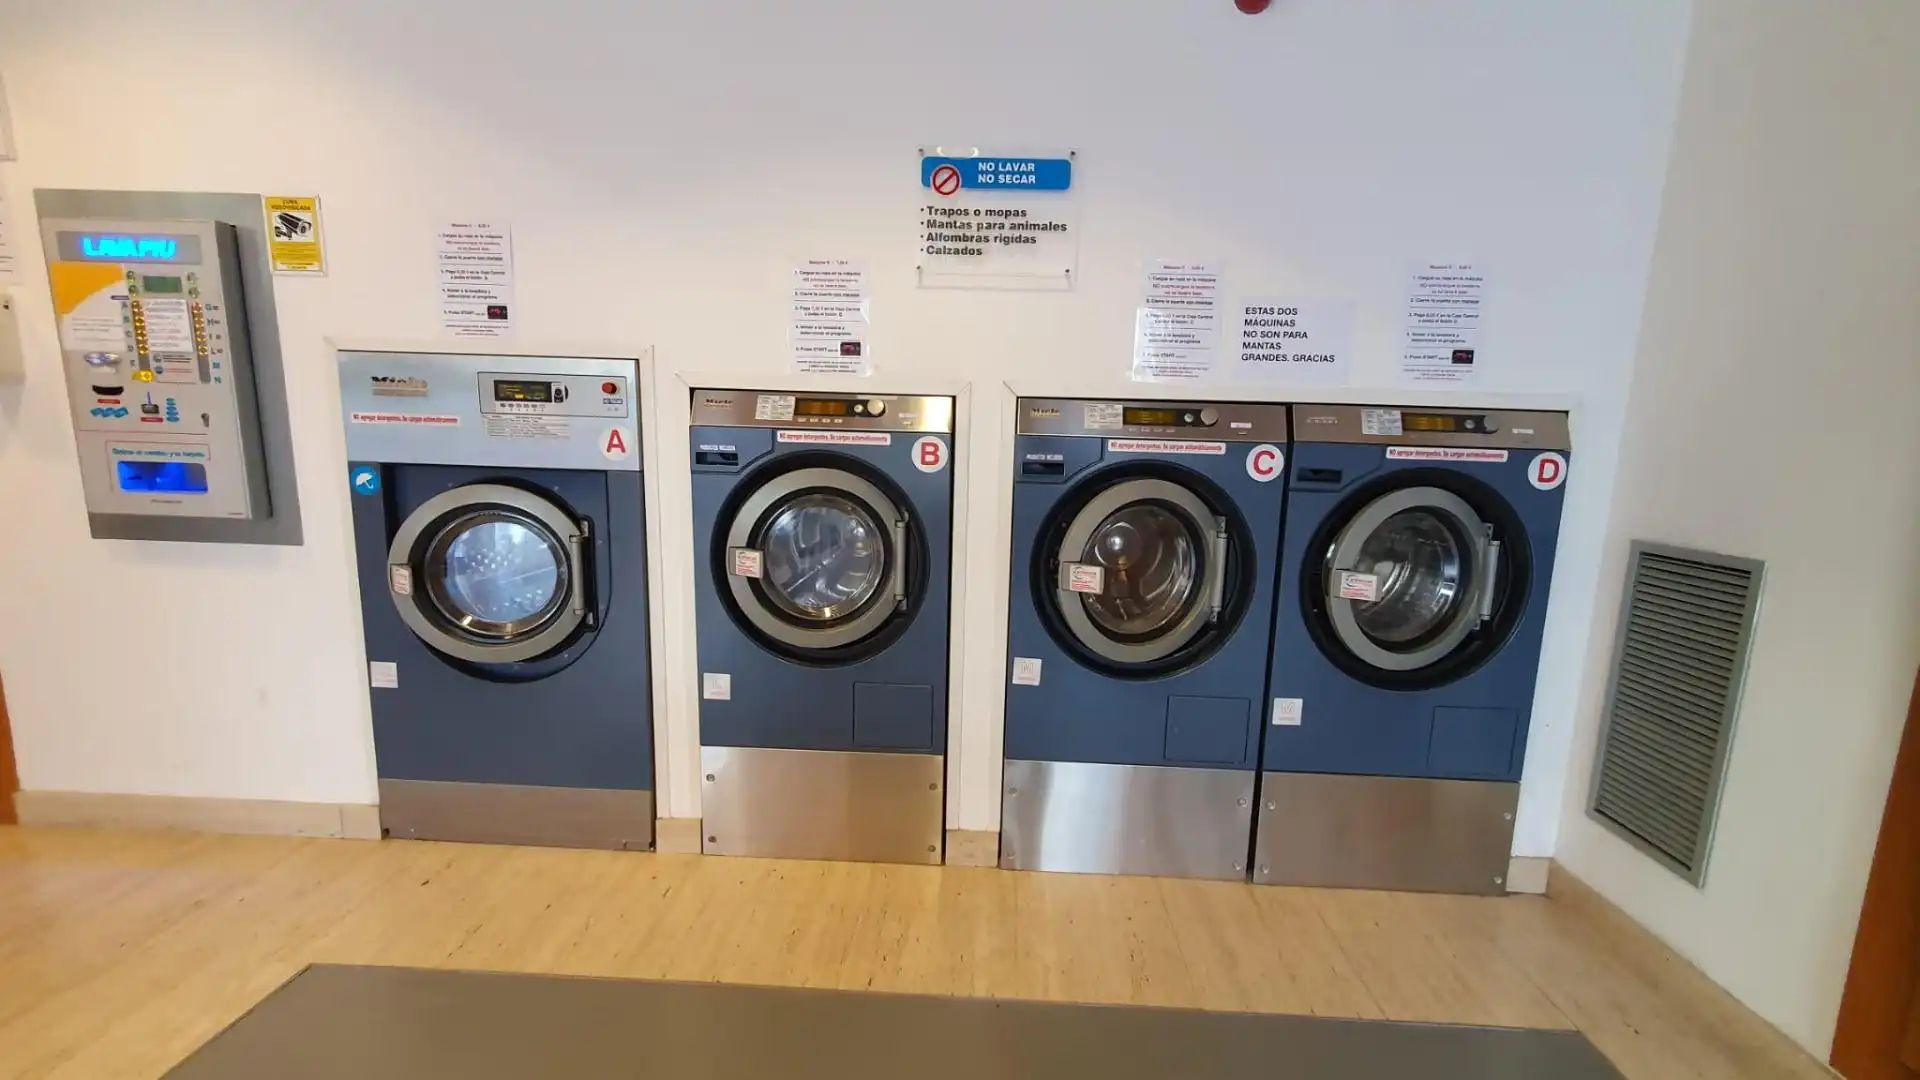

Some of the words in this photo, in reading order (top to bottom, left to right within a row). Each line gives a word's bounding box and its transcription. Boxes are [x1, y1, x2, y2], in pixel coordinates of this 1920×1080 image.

[978, 162, 995, 171] NO
[998, 162, 1035, 172] LAVAR
[977, 174, 995, 184] NO
[998, 174, 1036, 184] SECAR
[926, 206, 969, 218] Trapos
[985, 209, 1027, 219] mopas
[926, 219, 972, 230] Mantas
[977, 221, 1005, 232] para
[1008, 221, 1067, 232] animales
[926, 232, 990, 243] Alfombras
[926, 245, 982, 256] Calzados
[1245, 307, 1274, 315] ESTAS
[1277, 307, 1298, 315] DOS
[1243, 330, 1258, 338] NO
[1260, 330, 1280, 338] SON
[1283, 331, 1308, 339] PARA
[1242, 342, 1282, 350] MANTAS
[1241, 353, 1290, 362] GRANDES.
[1292, 354, 1335, 362] GRACIAS
[606, 429, 626, 453] A
[920, 442, 940, 466] B
[1253, 450, 1276, 475] C
[1537, 458, 1560, 483] D
